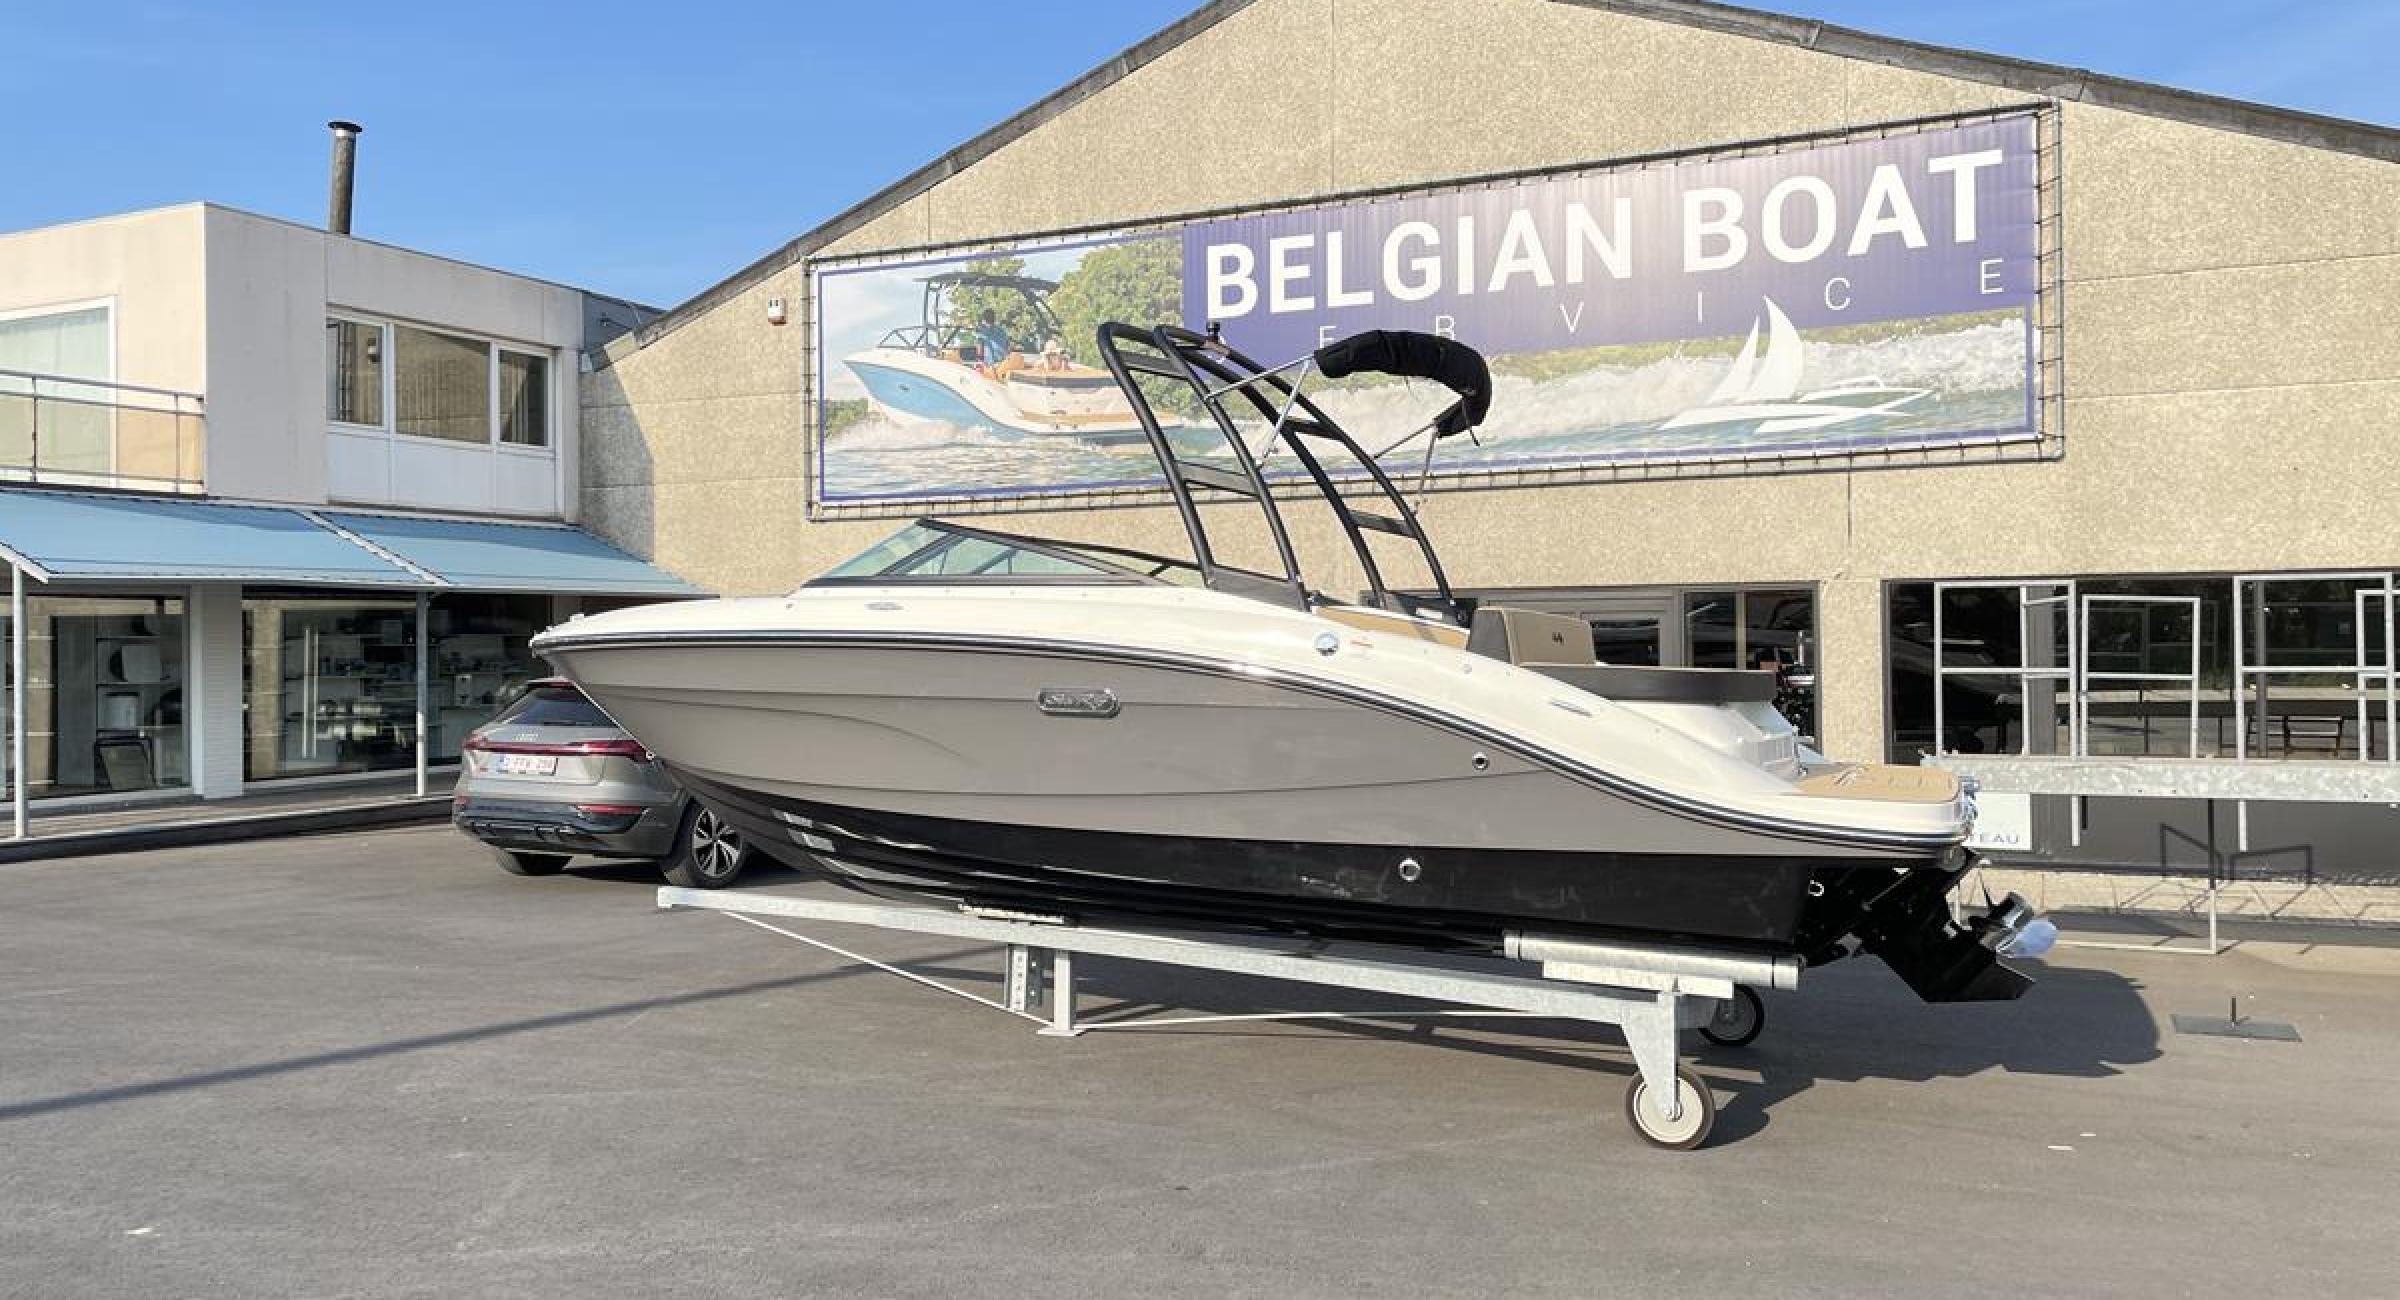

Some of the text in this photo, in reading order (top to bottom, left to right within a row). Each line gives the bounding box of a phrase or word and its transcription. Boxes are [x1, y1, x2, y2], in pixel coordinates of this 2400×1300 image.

[1206, 149, 2003, 320] BELGIAN BOAT
[1208, 257, 2004, 364] ERVICE
